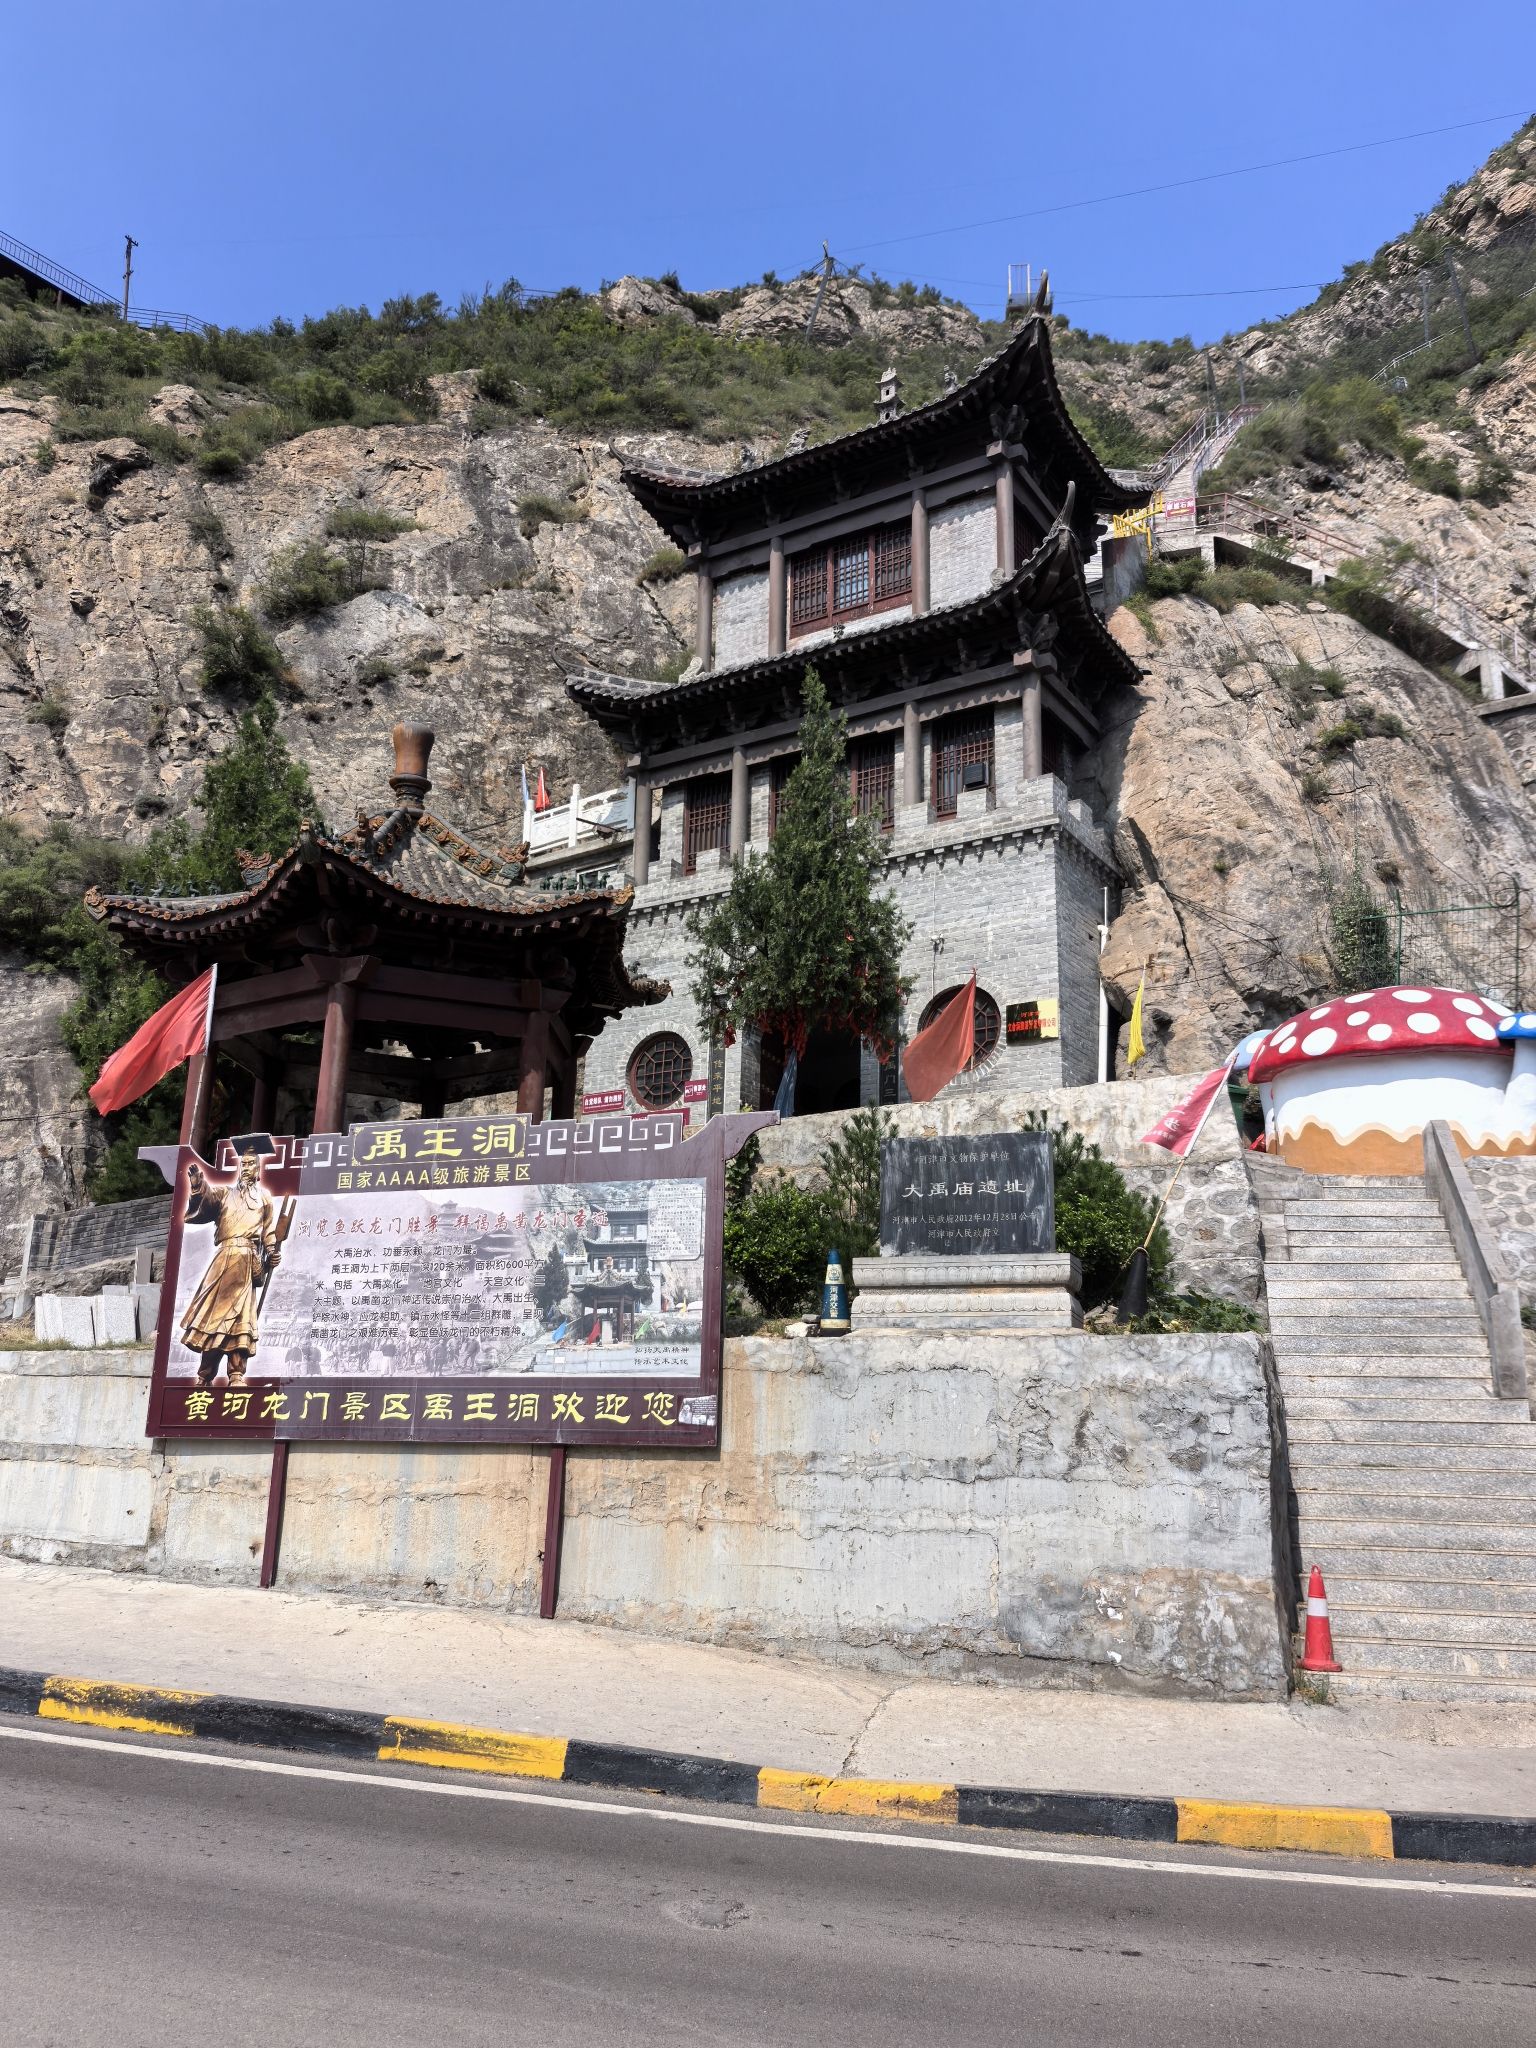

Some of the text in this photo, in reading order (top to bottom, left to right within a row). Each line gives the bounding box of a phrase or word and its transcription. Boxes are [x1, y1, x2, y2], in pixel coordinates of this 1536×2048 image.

[363, 1124, 515, 1160] 禹王洞
[337, 1163, 531, 1189] 国家AAAA级旅游景区
[902, 1178, 1026, 1198] 大禹庙遗址
[298, 1209, 609, 1237] 浏览鱼跃龙门胜景 拜谒禹凿龙门圣迹
[928, 1228, 1000, 1239] 河津市人民政府立
[185, 1391, 677, 1425] 黄河龙门景区禹王洞欢迎您
